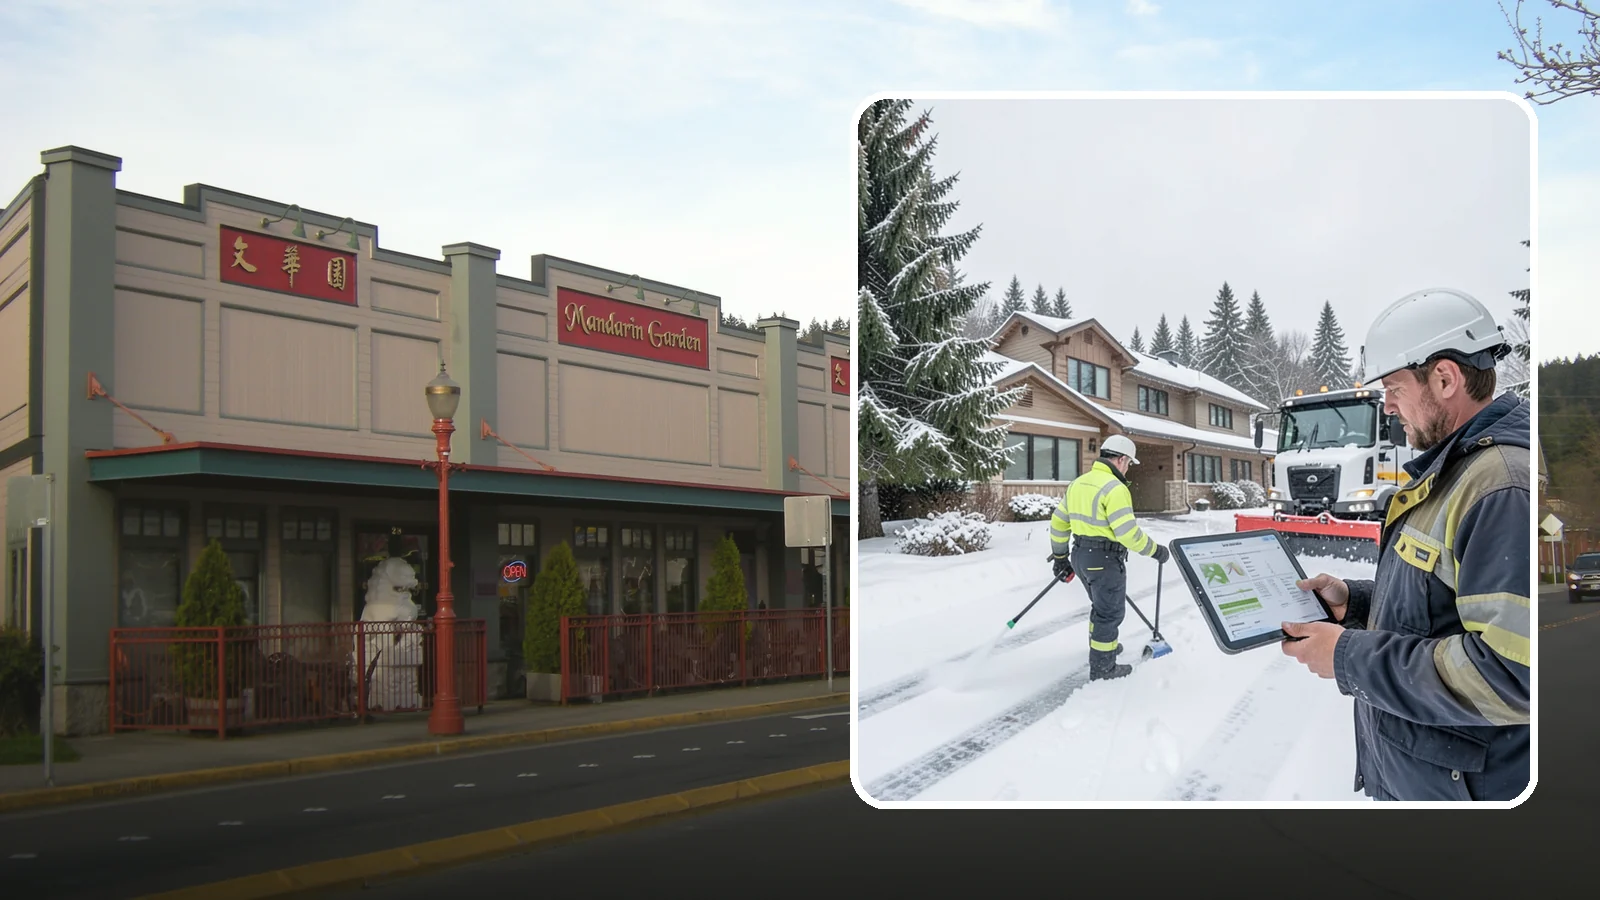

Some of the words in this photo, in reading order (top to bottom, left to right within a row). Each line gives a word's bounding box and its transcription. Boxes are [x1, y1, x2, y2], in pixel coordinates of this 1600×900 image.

[564, 302, 644, 341] Mandarin
[648, 320, 701, 352] Garden
[503, 565, 527, 578] OPEN
